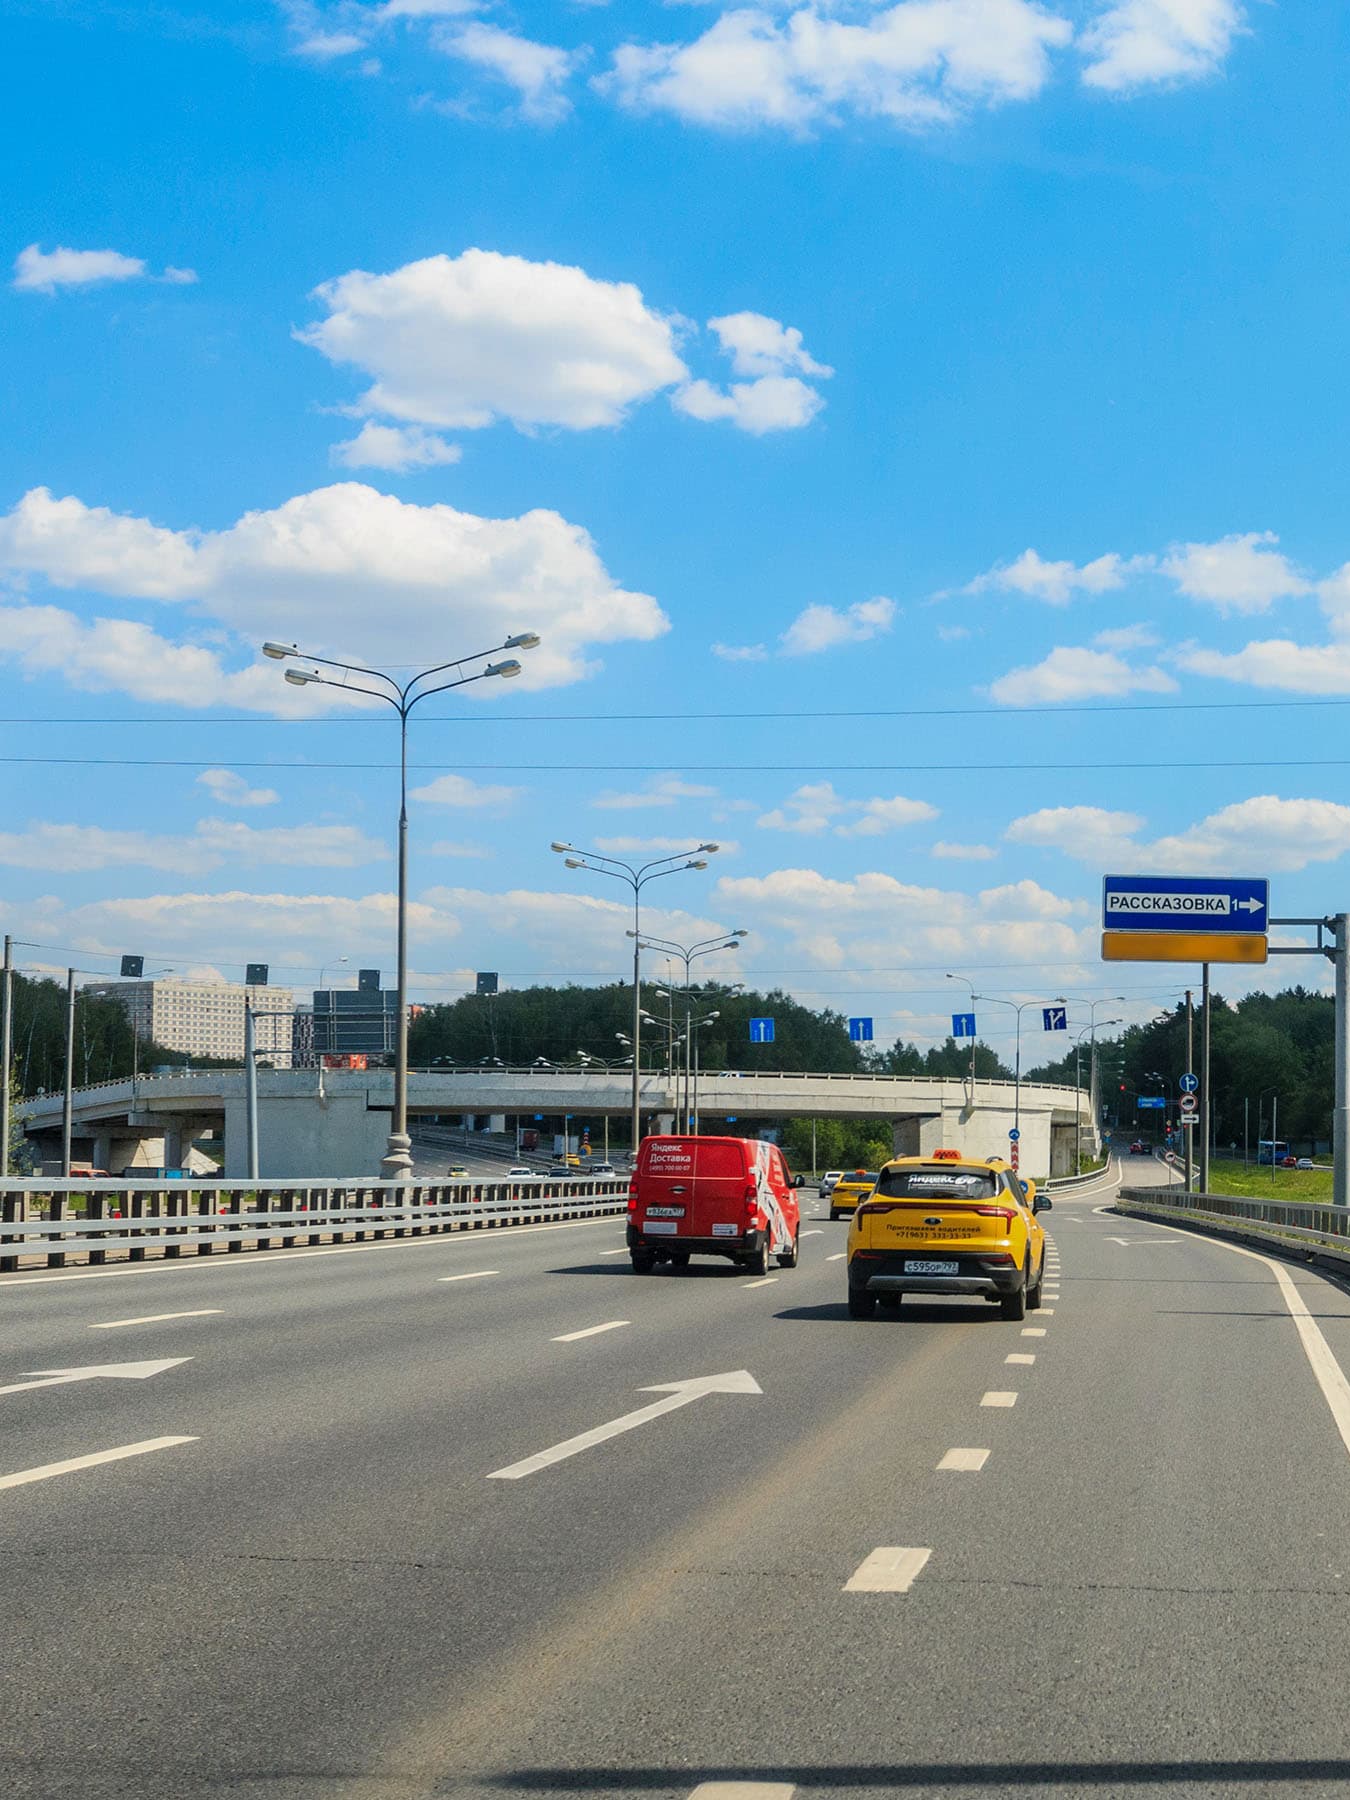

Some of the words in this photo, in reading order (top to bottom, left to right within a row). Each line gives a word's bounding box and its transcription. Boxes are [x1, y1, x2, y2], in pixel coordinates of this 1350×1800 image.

[1110, 896, 1226, 911] РАССКАЗОВКА
[650, 1143, 682, 1152] Яндекс
[649, 1154, 691, 1163] Доставка
[908, 1174, 955, 1185] Яндекс
